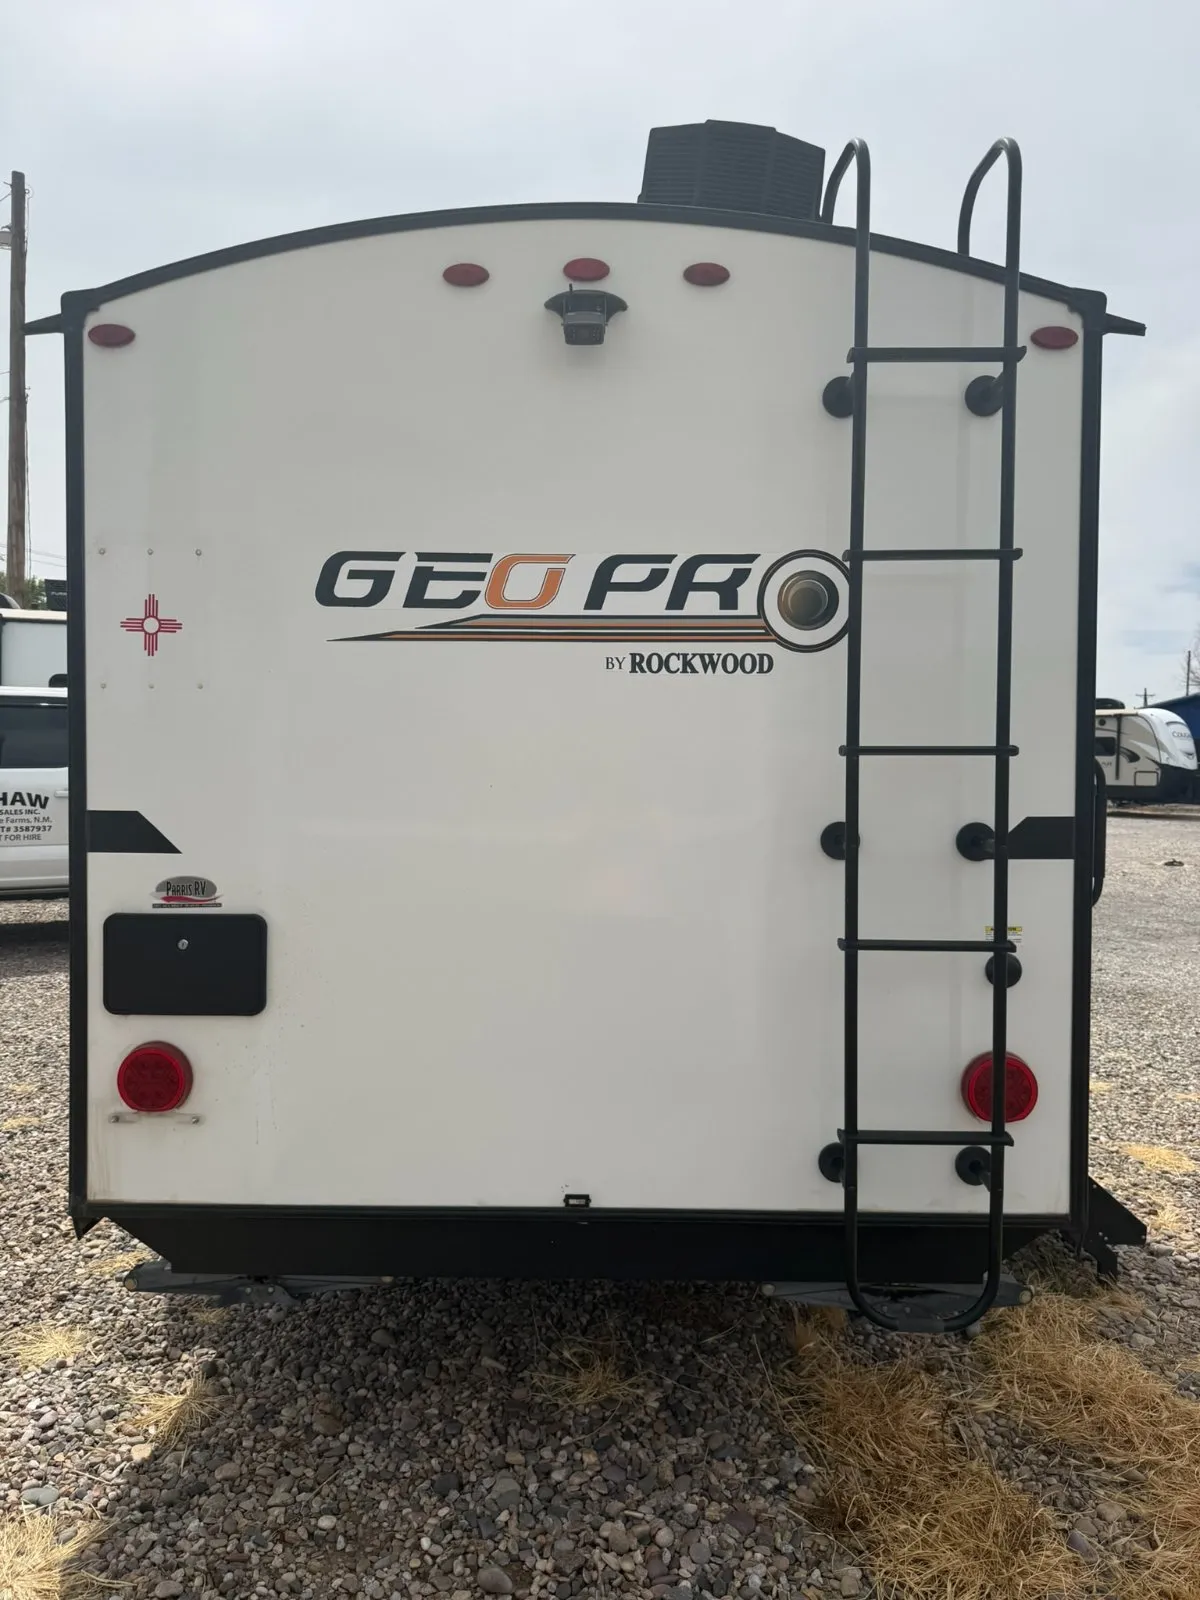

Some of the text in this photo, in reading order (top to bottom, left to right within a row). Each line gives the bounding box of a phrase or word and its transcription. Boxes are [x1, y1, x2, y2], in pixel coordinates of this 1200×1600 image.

[315, 550, 576, 610] GEO
[605, 652, 774, 674] BY ROCKWOOD
[194, 881, 206, 896] RV
